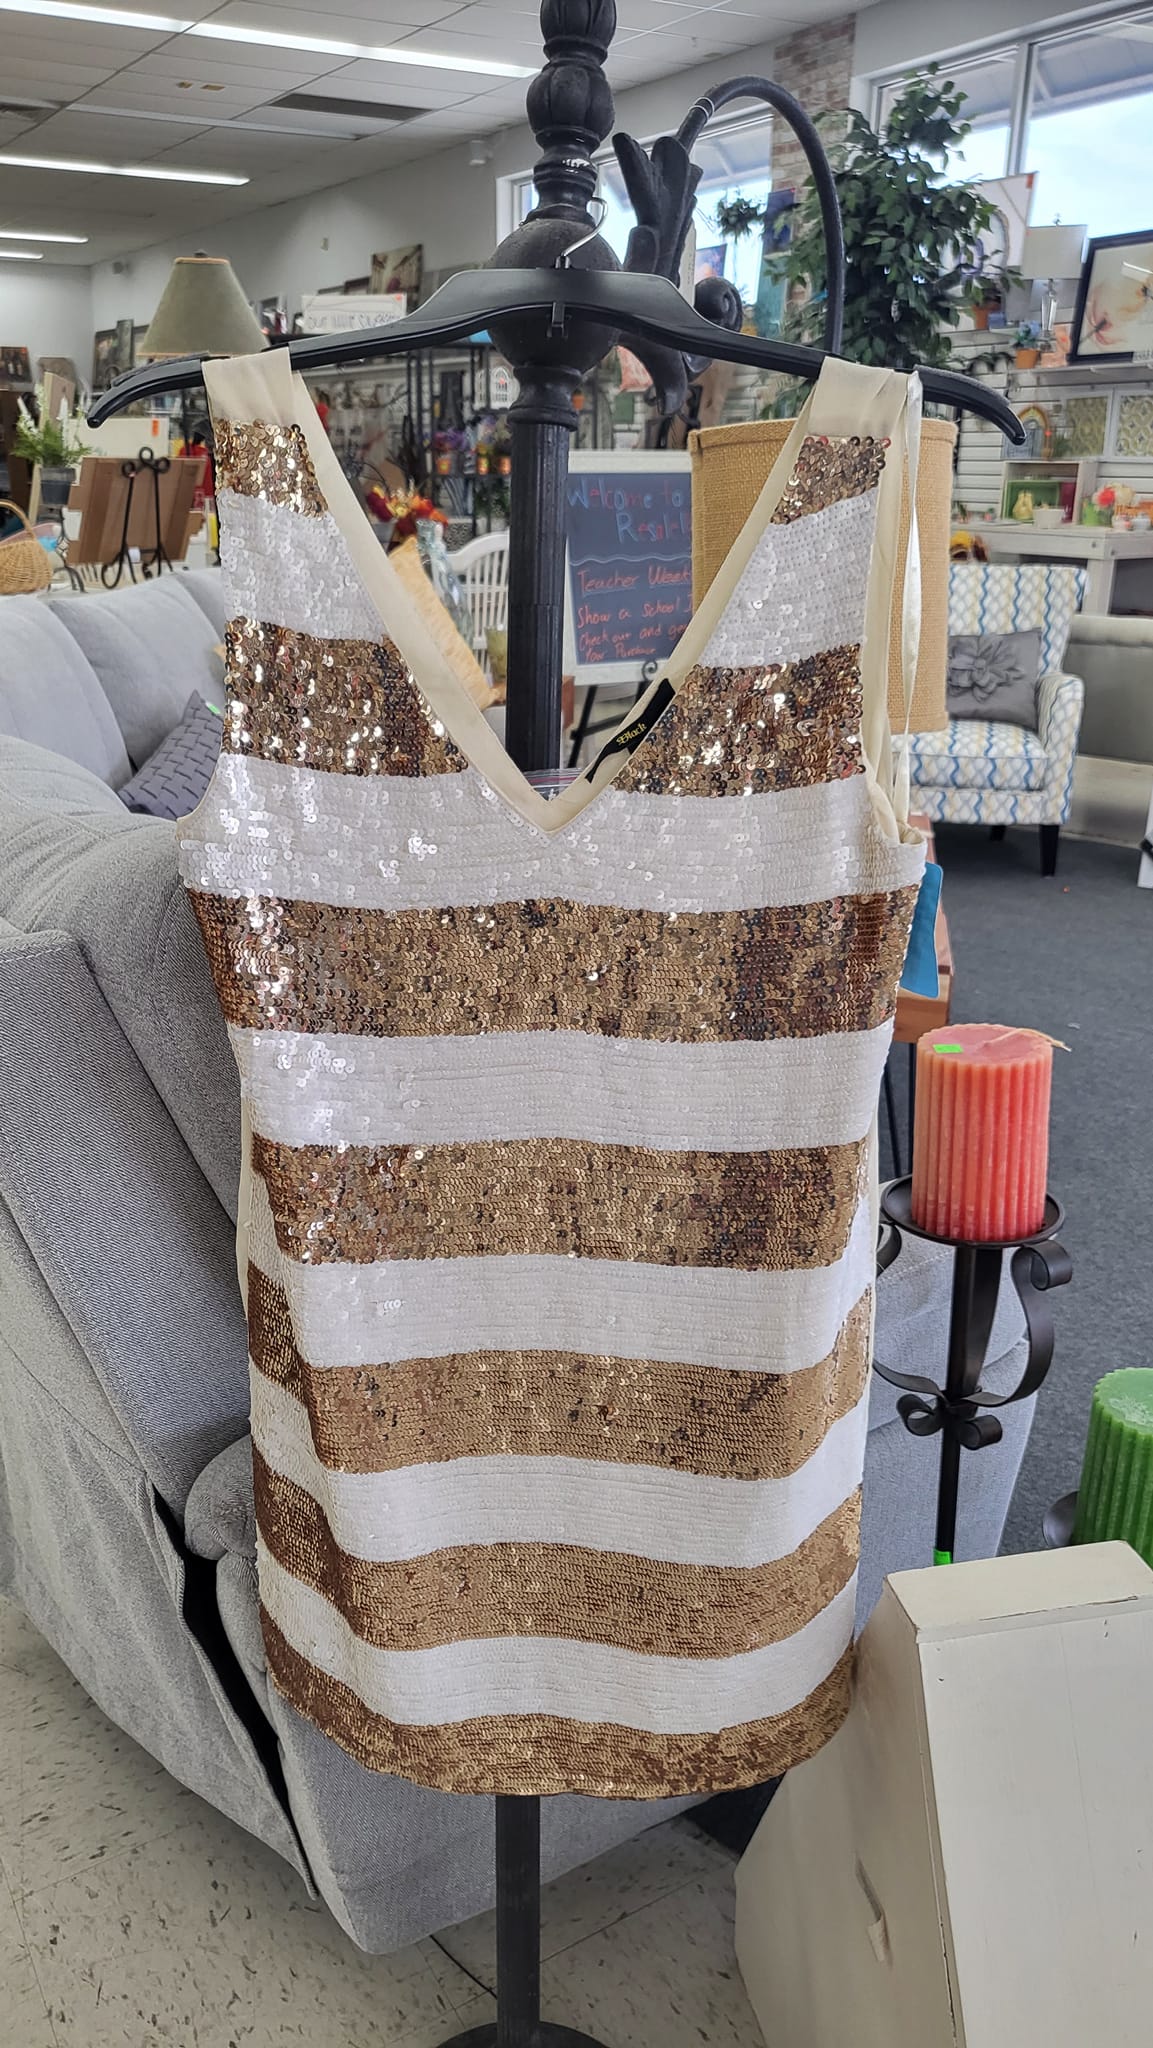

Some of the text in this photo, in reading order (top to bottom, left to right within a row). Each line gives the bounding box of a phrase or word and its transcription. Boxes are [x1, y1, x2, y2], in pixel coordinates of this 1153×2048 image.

[567, 477, 684, 510] Welcome to
[577, 569, 639, 594] Teacher
[577, 604, 611, 628] Show
[618, 608, 632, 620] a
[640, 624, 661, 640] and
